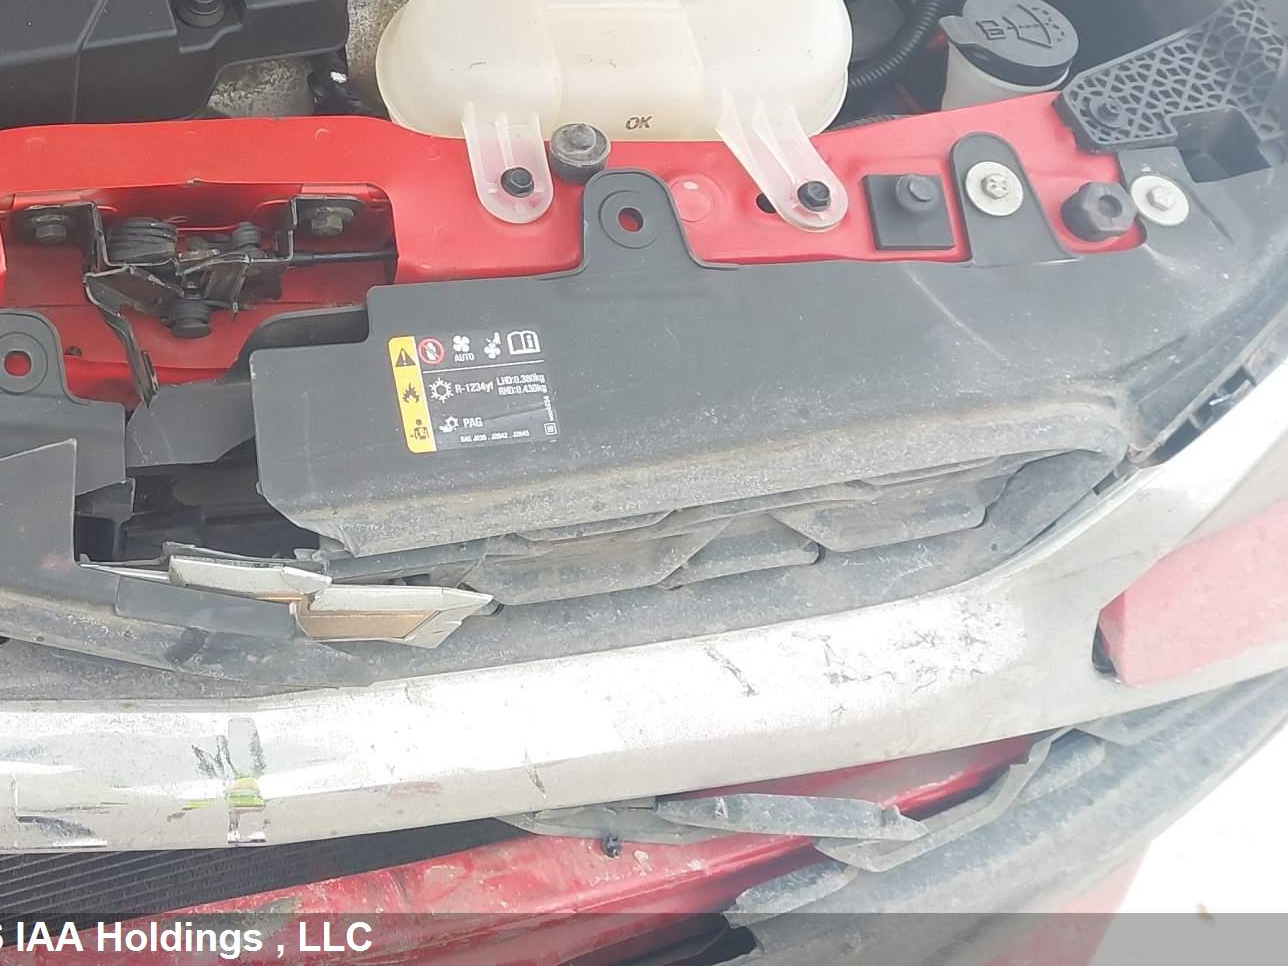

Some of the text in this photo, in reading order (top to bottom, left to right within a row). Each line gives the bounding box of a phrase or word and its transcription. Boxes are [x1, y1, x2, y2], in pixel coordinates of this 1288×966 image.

[626, 116, 652, 130] OK
[454, 353, 475, 362] AUTO
[463, 417, 484, 428] PAG
